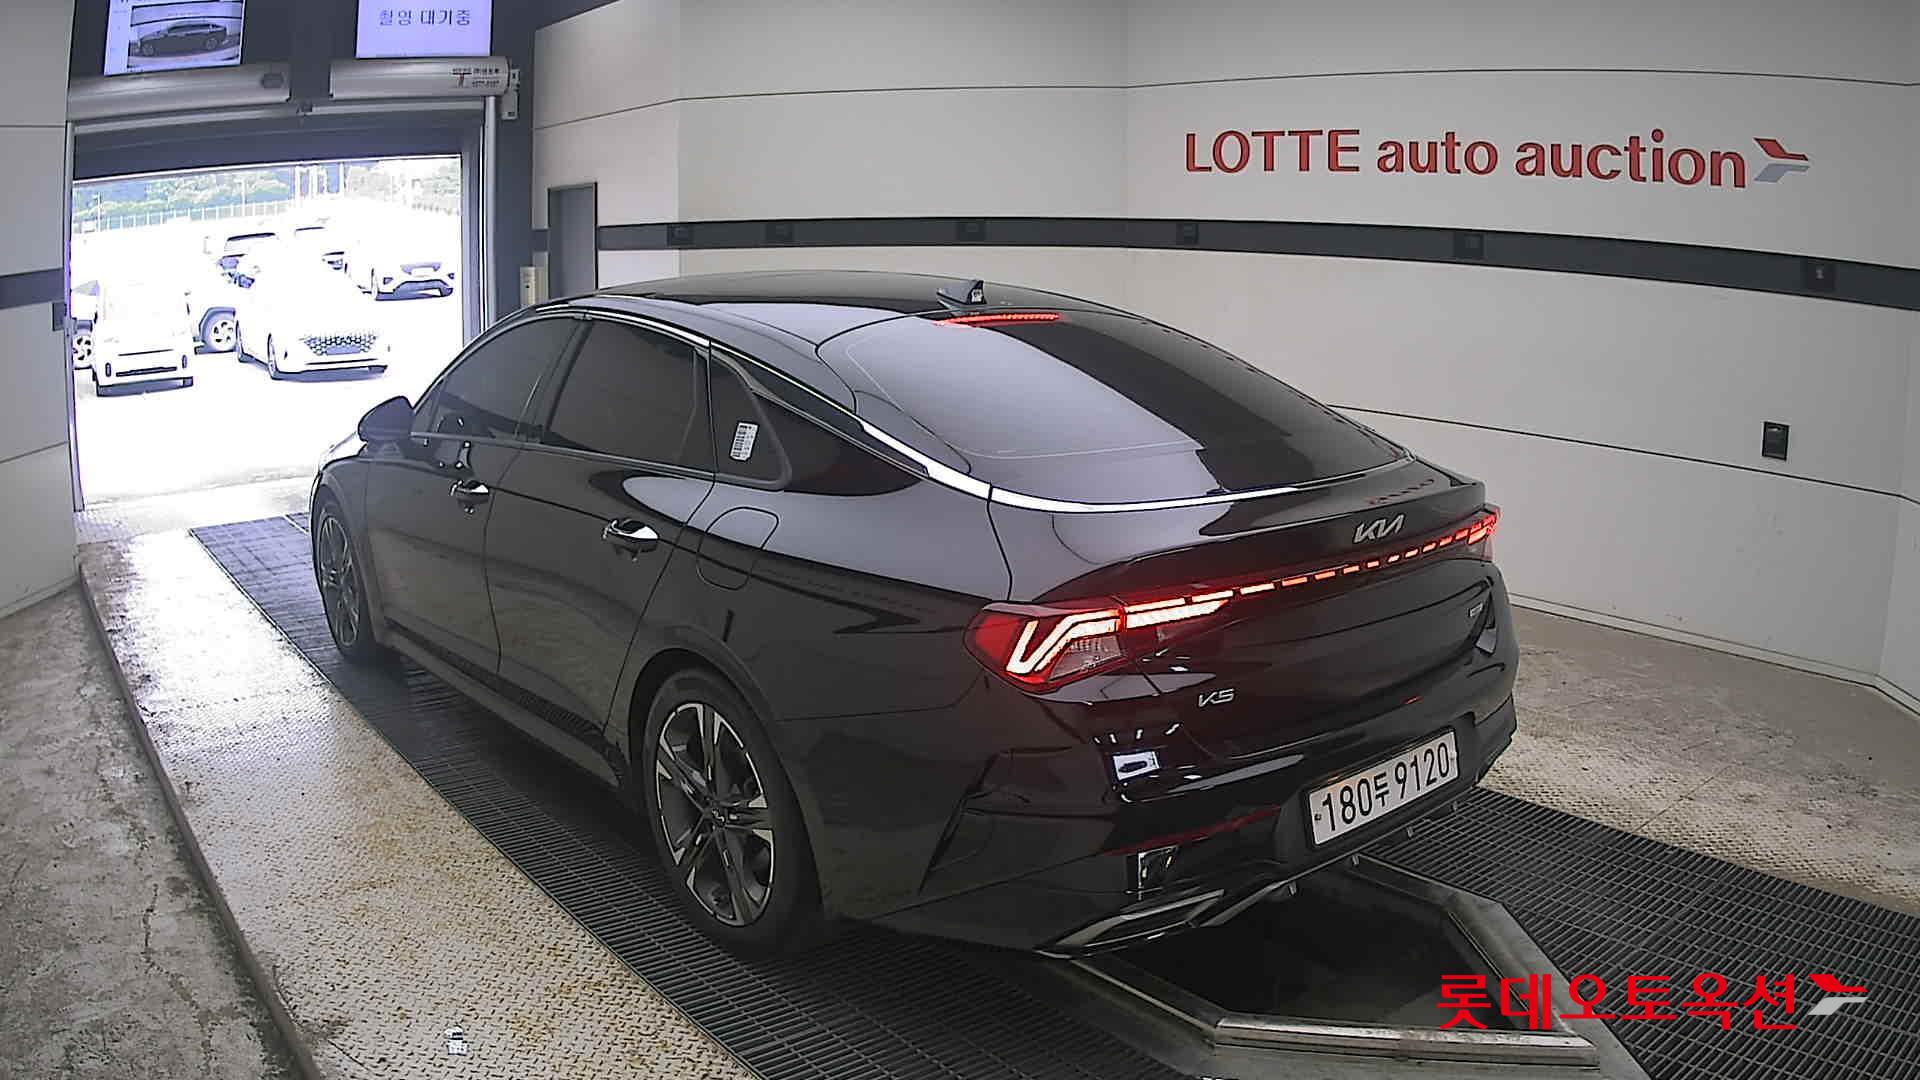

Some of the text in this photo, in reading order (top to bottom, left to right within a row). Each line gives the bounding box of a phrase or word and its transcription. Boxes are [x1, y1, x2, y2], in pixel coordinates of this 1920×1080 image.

[1185, 128, 1746, 189] LOTTE auto auction
[1353, 514, 1405, 544] KIA
[1198, 687, 1235, 708] K5
[1394, 742, 1450, 799] 9120
